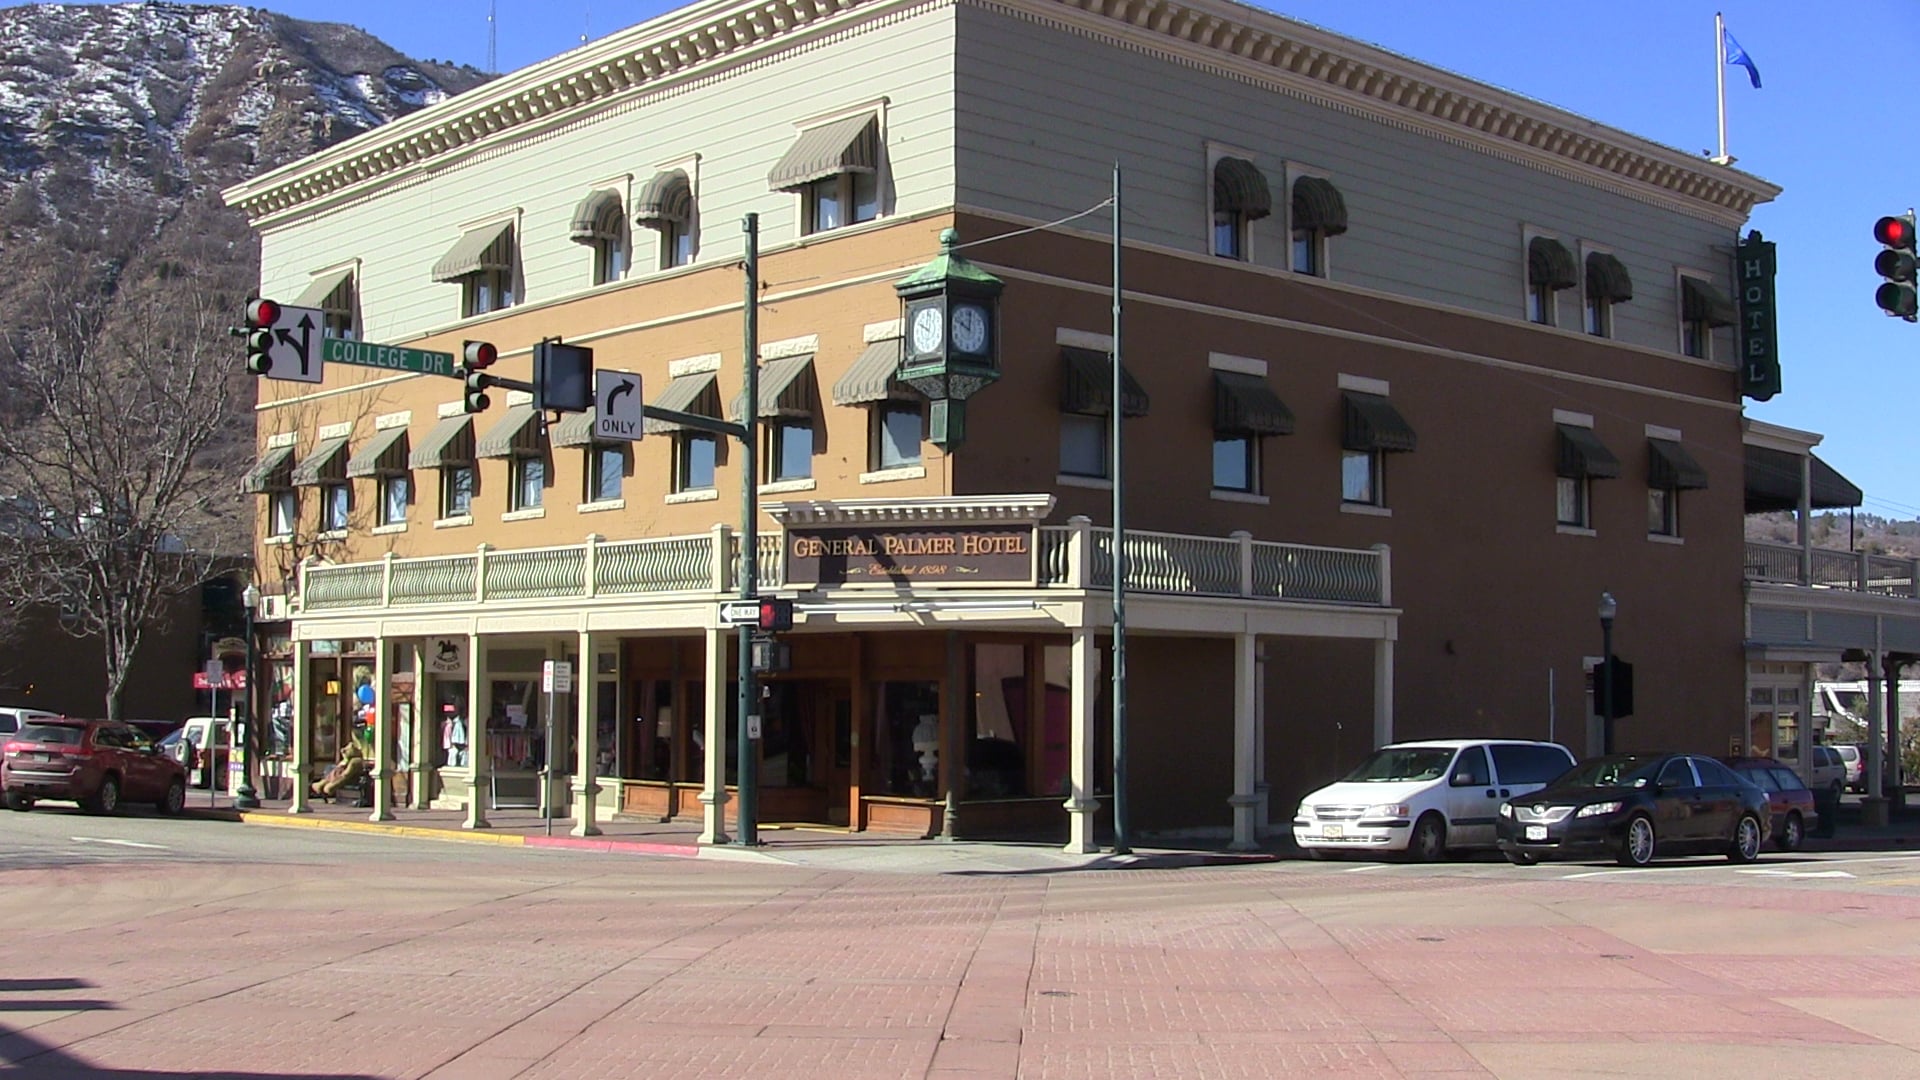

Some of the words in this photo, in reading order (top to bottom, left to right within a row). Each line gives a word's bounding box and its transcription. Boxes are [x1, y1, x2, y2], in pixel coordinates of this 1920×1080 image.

[1744, 259, 1765, 382] HOTEL
[331, 340, 408, 369] COLLEGE
[422, 351, 445, 374] DR
[601, 419, 636, 434] ONLY
[793, 537, 878, 558] GENERAL
[884, 536, 957, 556] PALMER
[961, 534, 1028, 555] HOTEL
[868, 563, 917, 576] Established
[919, 563, 948, 576] 1898
[731, 608, 742, 617] ONE
[744, 608, 756, 616] WAY
